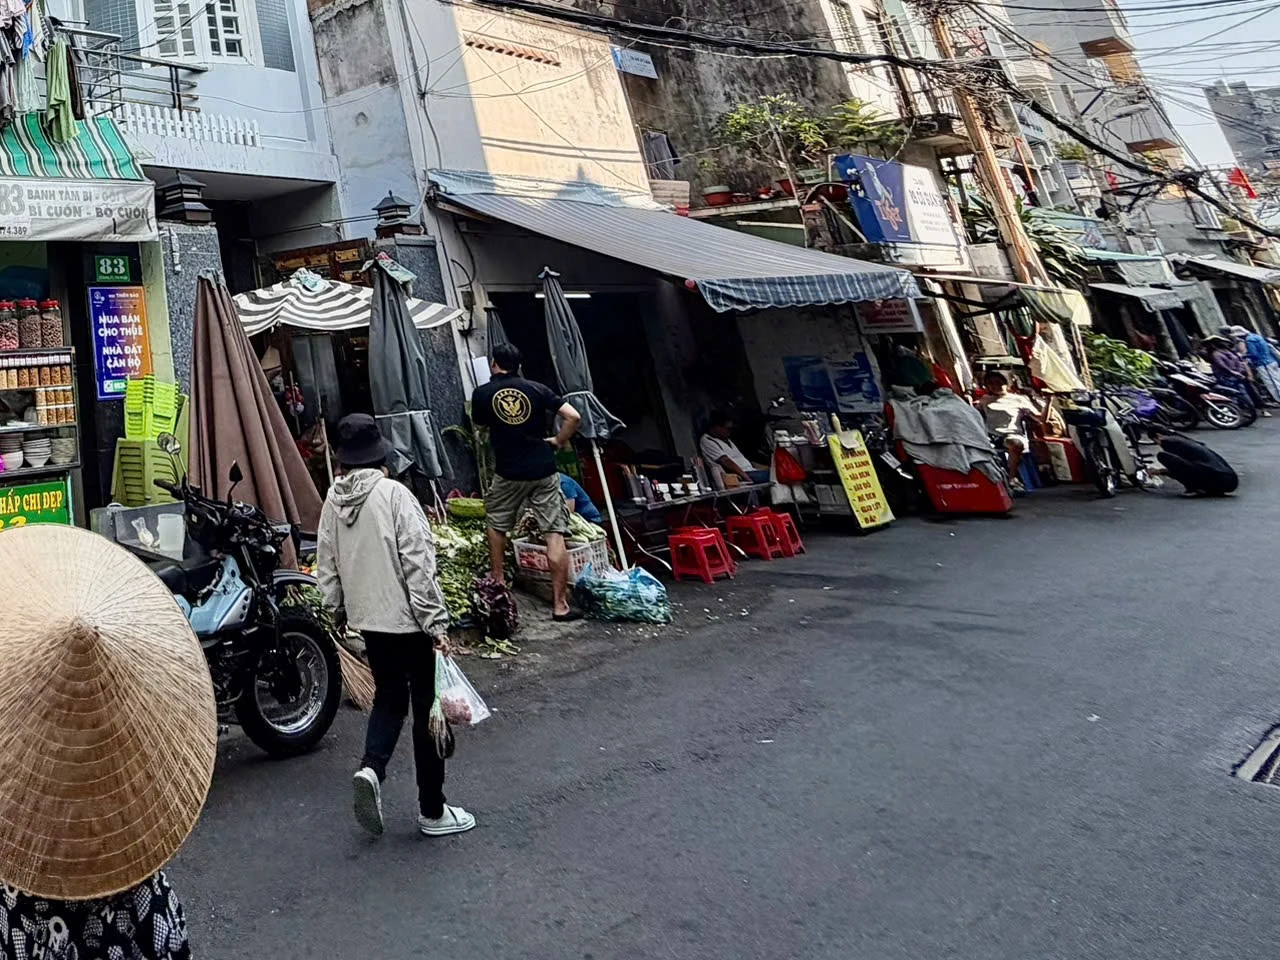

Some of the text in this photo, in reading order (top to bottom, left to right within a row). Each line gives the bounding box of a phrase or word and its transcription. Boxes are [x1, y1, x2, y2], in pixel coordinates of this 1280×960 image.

[100, 258, 125, 274] 83
[99, 313, 140, 324] MUA BÁN
[98, 326, 143, 337] CHO THUÊ
[102, 343, 143, 355] NHÀ ĐẤT
[0, 489, 21, 514] HẤP
[23, 493, 41, 514] CHỊ
[43, 490, 63, 512] ĐẸP
